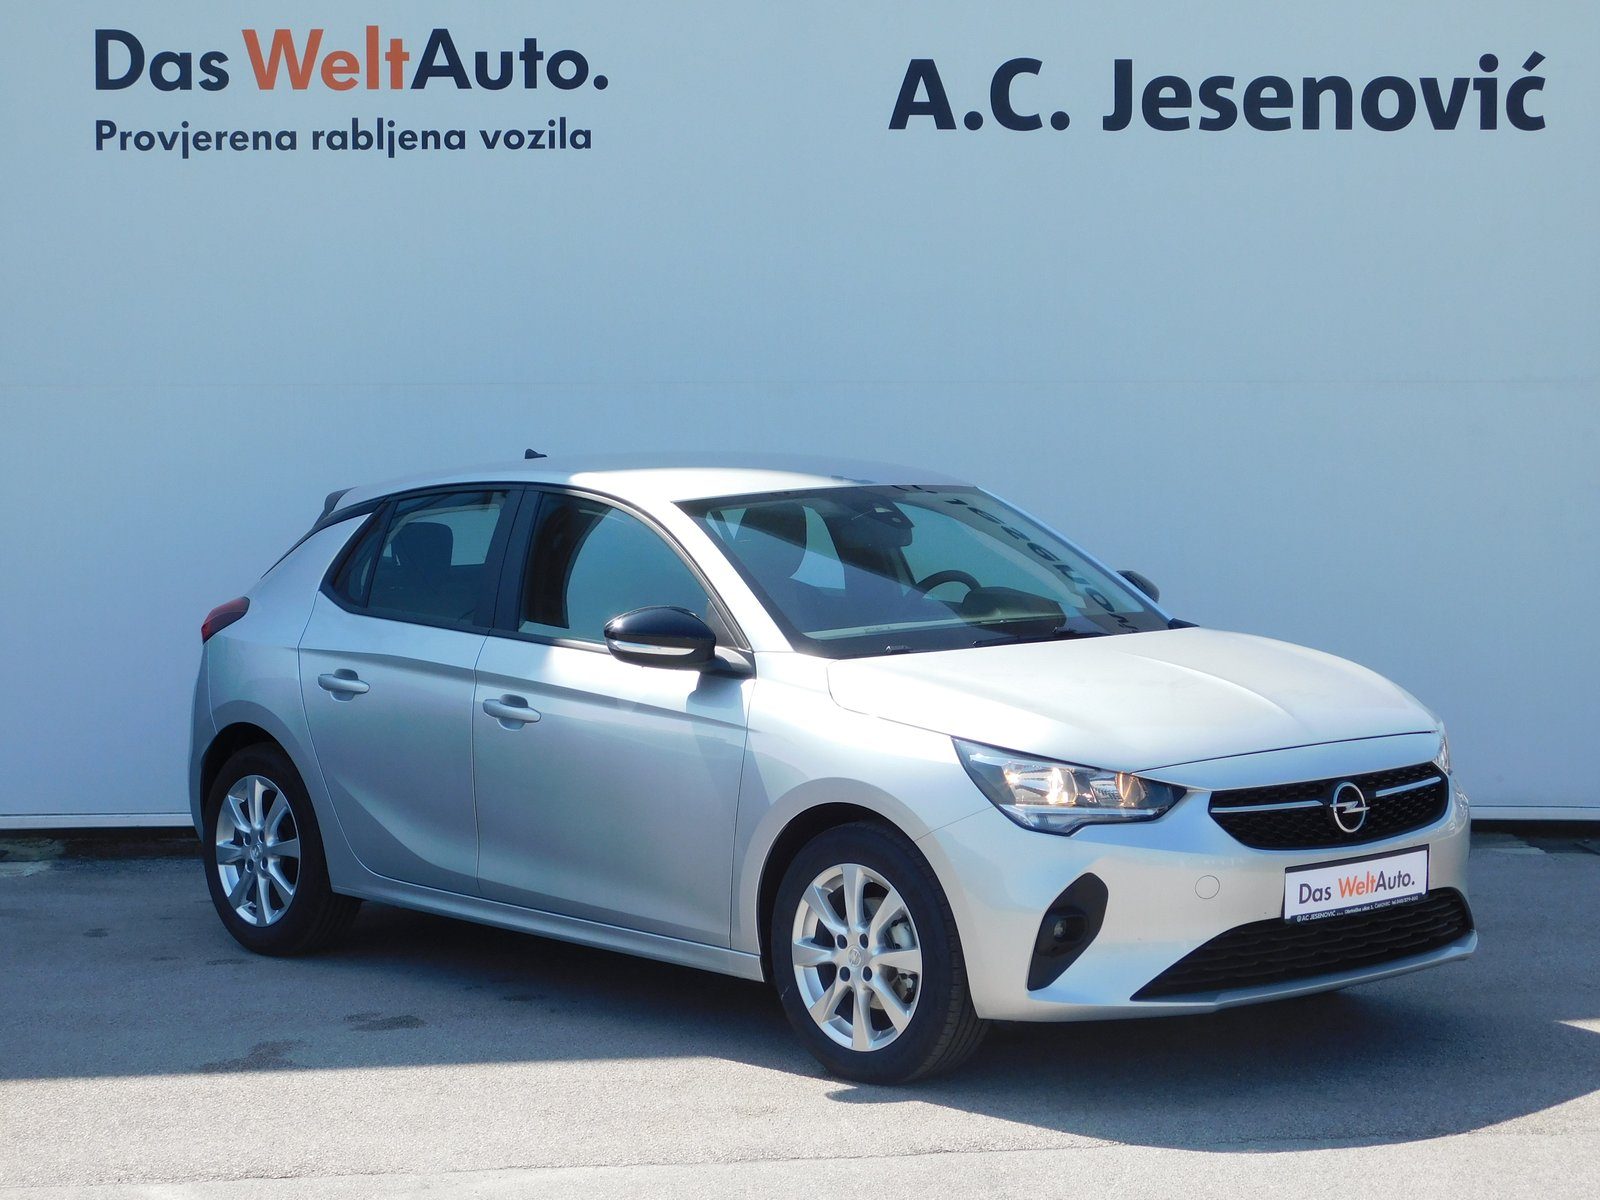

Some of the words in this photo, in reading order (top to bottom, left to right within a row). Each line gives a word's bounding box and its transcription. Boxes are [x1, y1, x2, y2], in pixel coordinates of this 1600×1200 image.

[95, 28, 230, 92] Das
[241, 25, 609, 92] WeltAuto.
[888, 57, 1071, 132] A.C.
[1102, 50, 1546, 132] Jesenović
[95, 119, 298, 159] Provjerena
[311, 117, 467, 158] rabljena
[479, 116, 592, 151] vozila
[1298, 883, 1332, 905] Das
[1338, 870, 1415, 899] WeltAuto.
